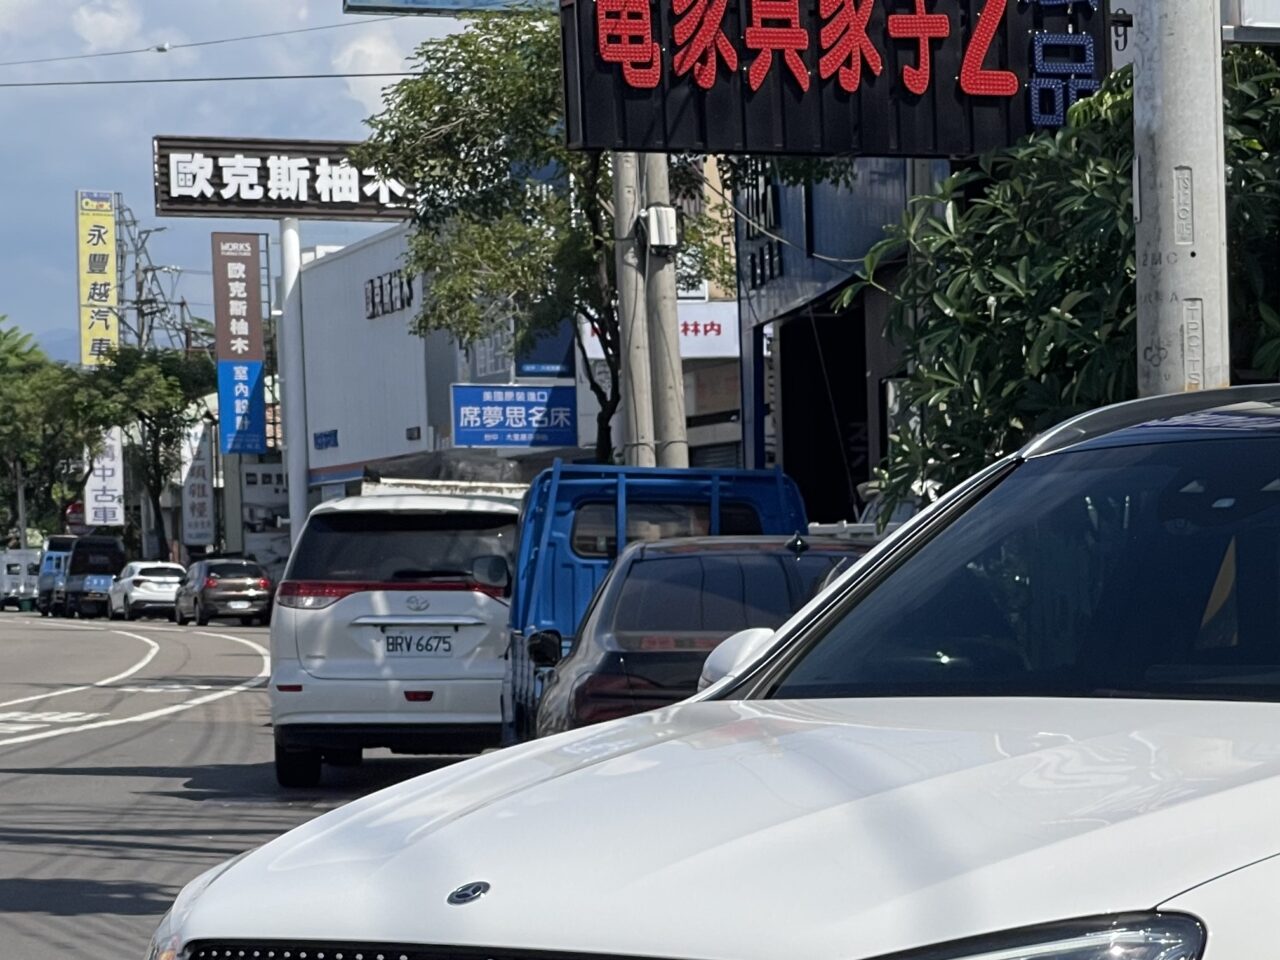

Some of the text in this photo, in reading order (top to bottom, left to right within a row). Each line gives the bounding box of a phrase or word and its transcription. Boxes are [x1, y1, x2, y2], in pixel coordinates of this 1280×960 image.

[168, 153, 405, 203] 歐克斯柚木
[233, 365, 250, 430] 室內設計
[460, 406, 571, 428] 席夢思名床
